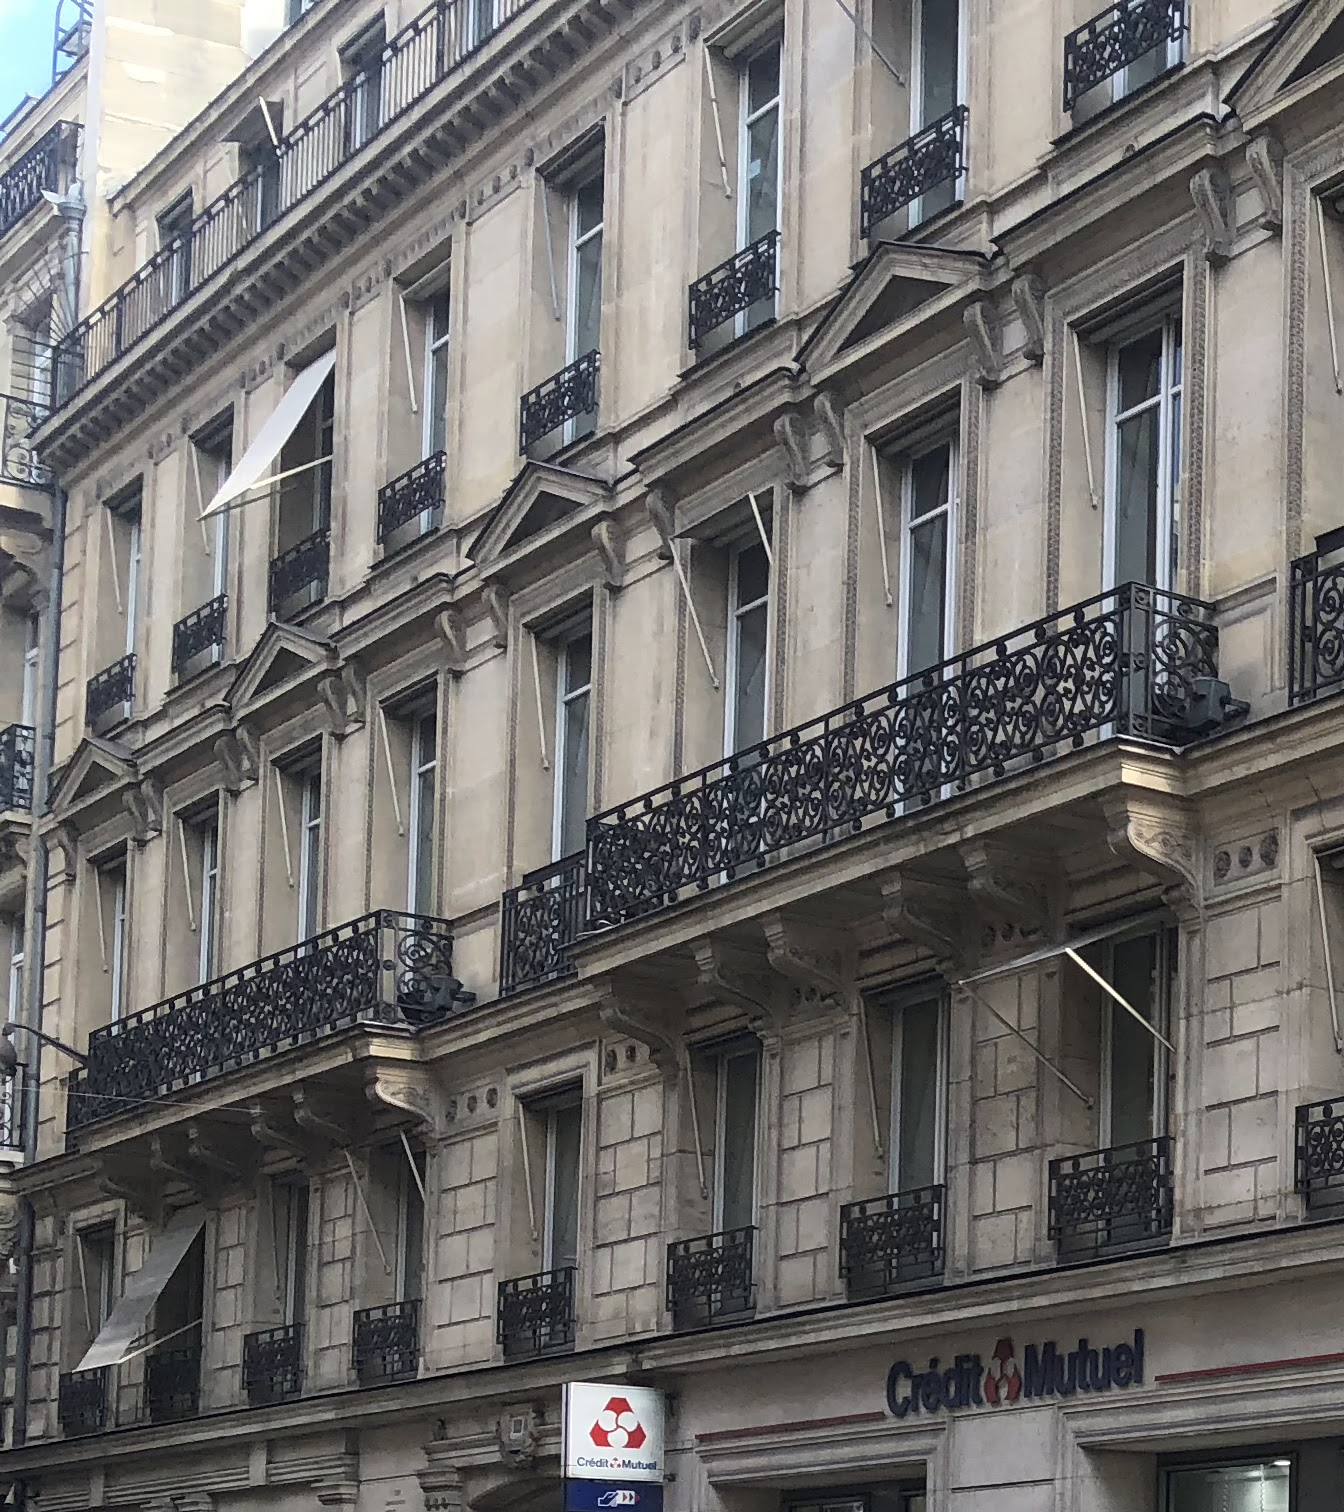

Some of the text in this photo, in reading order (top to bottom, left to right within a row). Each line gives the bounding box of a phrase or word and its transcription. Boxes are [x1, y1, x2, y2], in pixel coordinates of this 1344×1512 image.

[886, 1328, 1145, 1418] Crédit Mutuel
[576, 1456, 657, 1471] Crédit Mutuel
